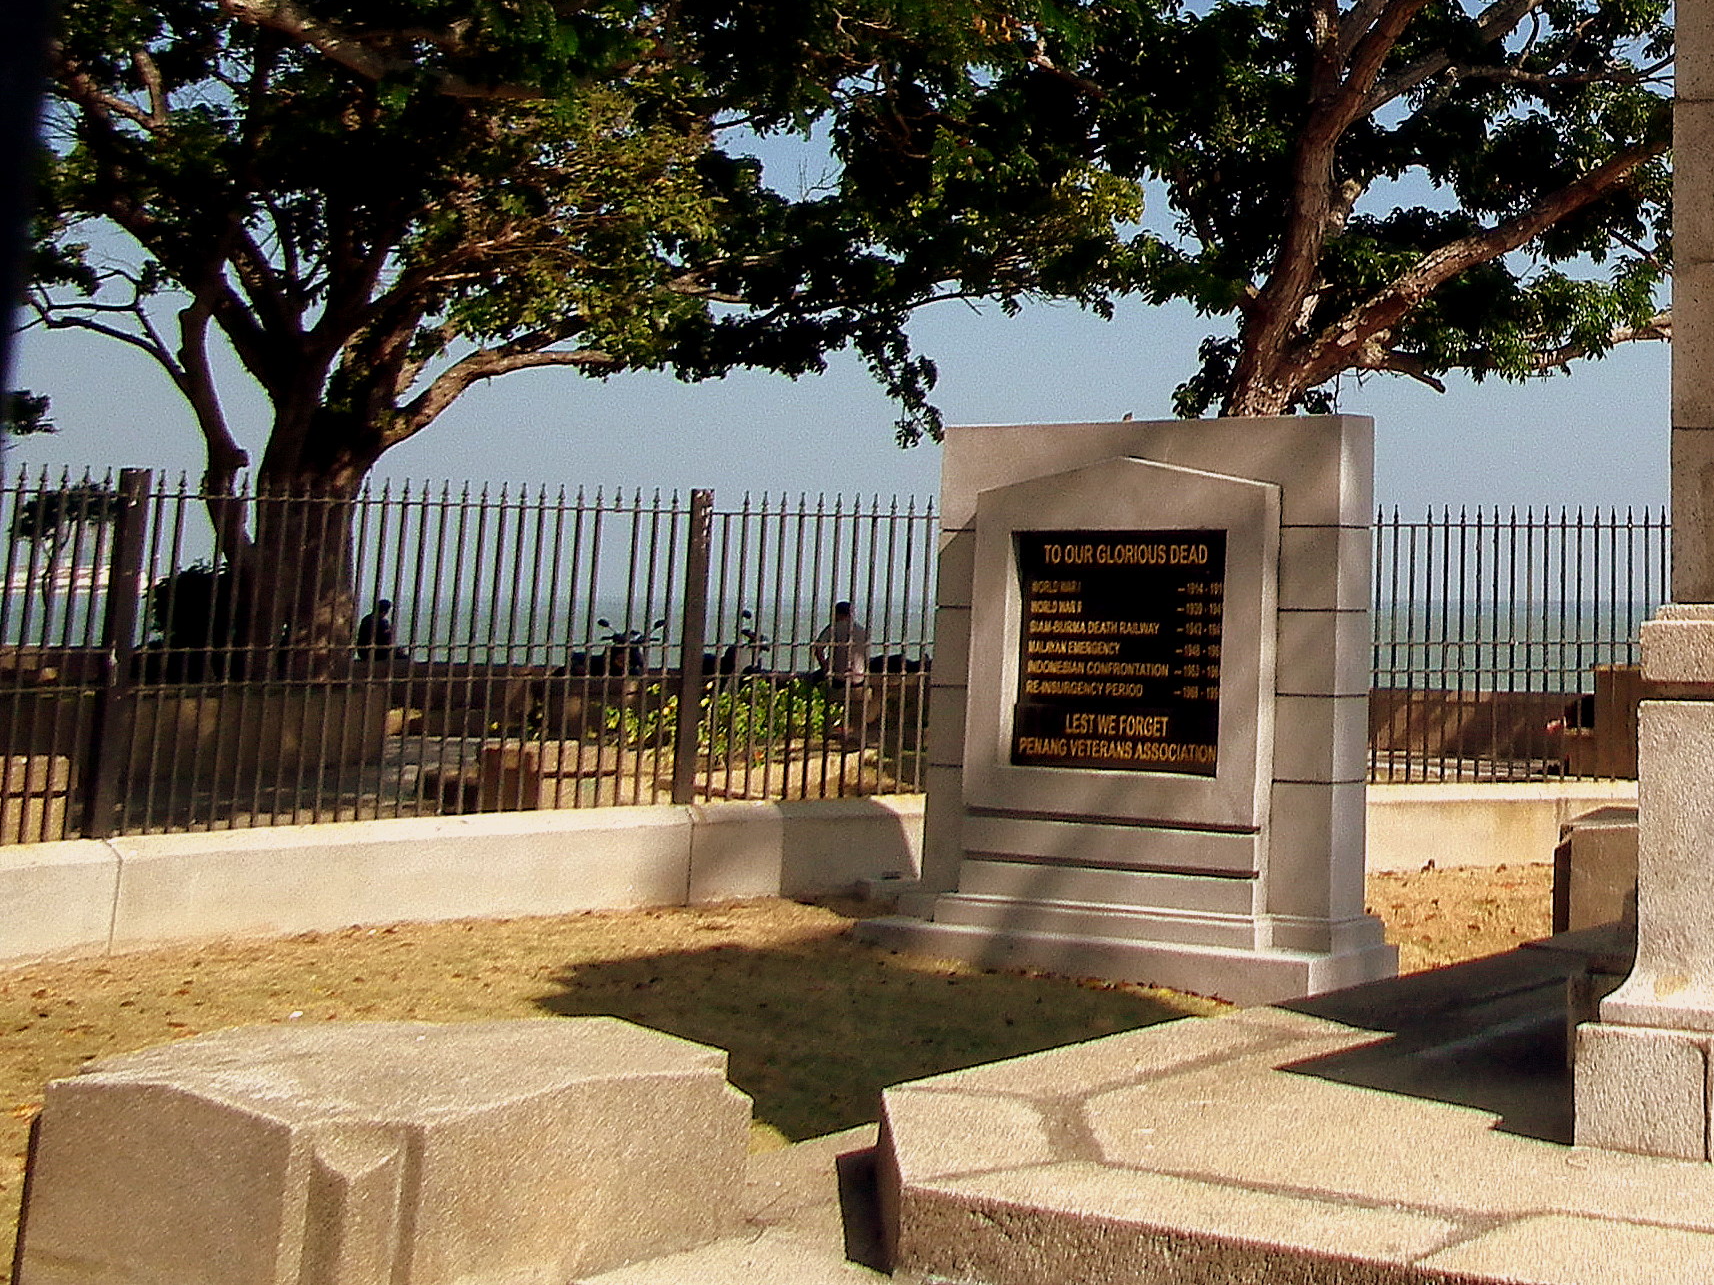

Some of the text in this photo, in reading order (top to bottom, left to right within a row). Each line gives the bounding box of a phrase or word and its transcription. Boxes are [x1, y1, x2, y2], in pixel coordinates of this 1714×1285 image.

[1044, 544, 1208, 564] TO OUR GLORIOUS DEAD
[1031, 580, 1058, 593] WORLD
[1030, 600, 1058, 613] WORLD
[1059, 600, 1076, 613] WAR
[1088, 620, 1118, 634] DEATH
[1120, 621, 1160, 635] RAILWAY
[1028, 639, 1068, 654] MALAYAN
[1069, 641, 1121, 655] EMERGENCY
[1027, 659, 1085, 675] INDONESIAN
[1086, 661, 1169, 677] CONFRONTATION
[1105, 683, 1144, 698] PERIOD
[1065, 713, 1169, 737] LEST WE FORGET
[1018, 737, 1216, 763] PENANG VETERANS ASSOCIATION
